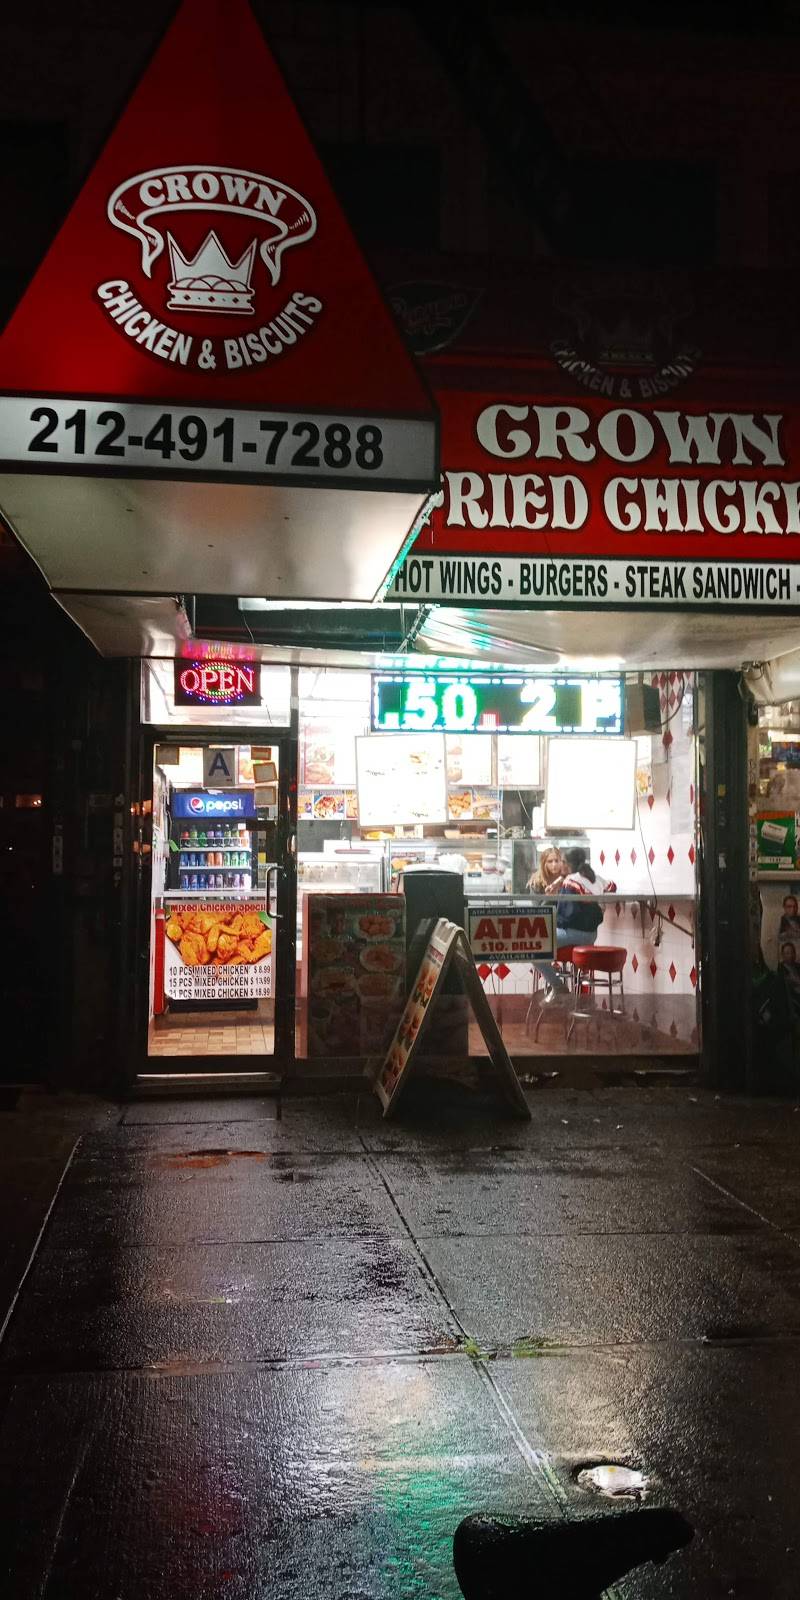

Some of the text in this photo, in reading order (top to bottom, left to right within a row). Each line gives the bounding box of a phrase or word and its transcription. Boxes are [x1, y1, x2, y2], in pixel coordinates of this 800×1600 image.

[138, 172, 287, 216] CROWN
[97, 279, 193, 366] CHICKEN
[198, 339, 216, 370] &
[224, 292, 323, 369] BISCUITS
[619, 379, 632, 398] &
[27, 407, 384, 471] 212-491-7288
[476, 404, 786, 467] CROWN
[395, 560, 434, 593] HOT
[440, 560, 502, 595] WINGS
[520, 563, 608, 598] BURGERS
[625, 565, 687, 598] STEAK
[692, 567, 791, 601] SANDWICH
[180, 669, 254, 693] OPEN
[208, 751, 231, 777] A
[205, 798, 243, 813] pepsi
[473, 917, 549, 940] ATM
[481, 941, 542, 953] $10. BILLS
[169, 966, 178, 976] 10
[179, 966, 193, 976] PCS
[194, 966, 216, 975] MIXED
[218, 965, 249, 975] CHICKEN
[169, 977, 177, 988] 15
[179, 977, 193, 987] PCS
[194, 977, 216, 987] MIXED
[218, 976, 249, 986] CHICKEN
[179, 989, 193, 998] PCS
[194, 988, 216, 998] MIXED
[218, 988, 249, 998] CHICKEN
